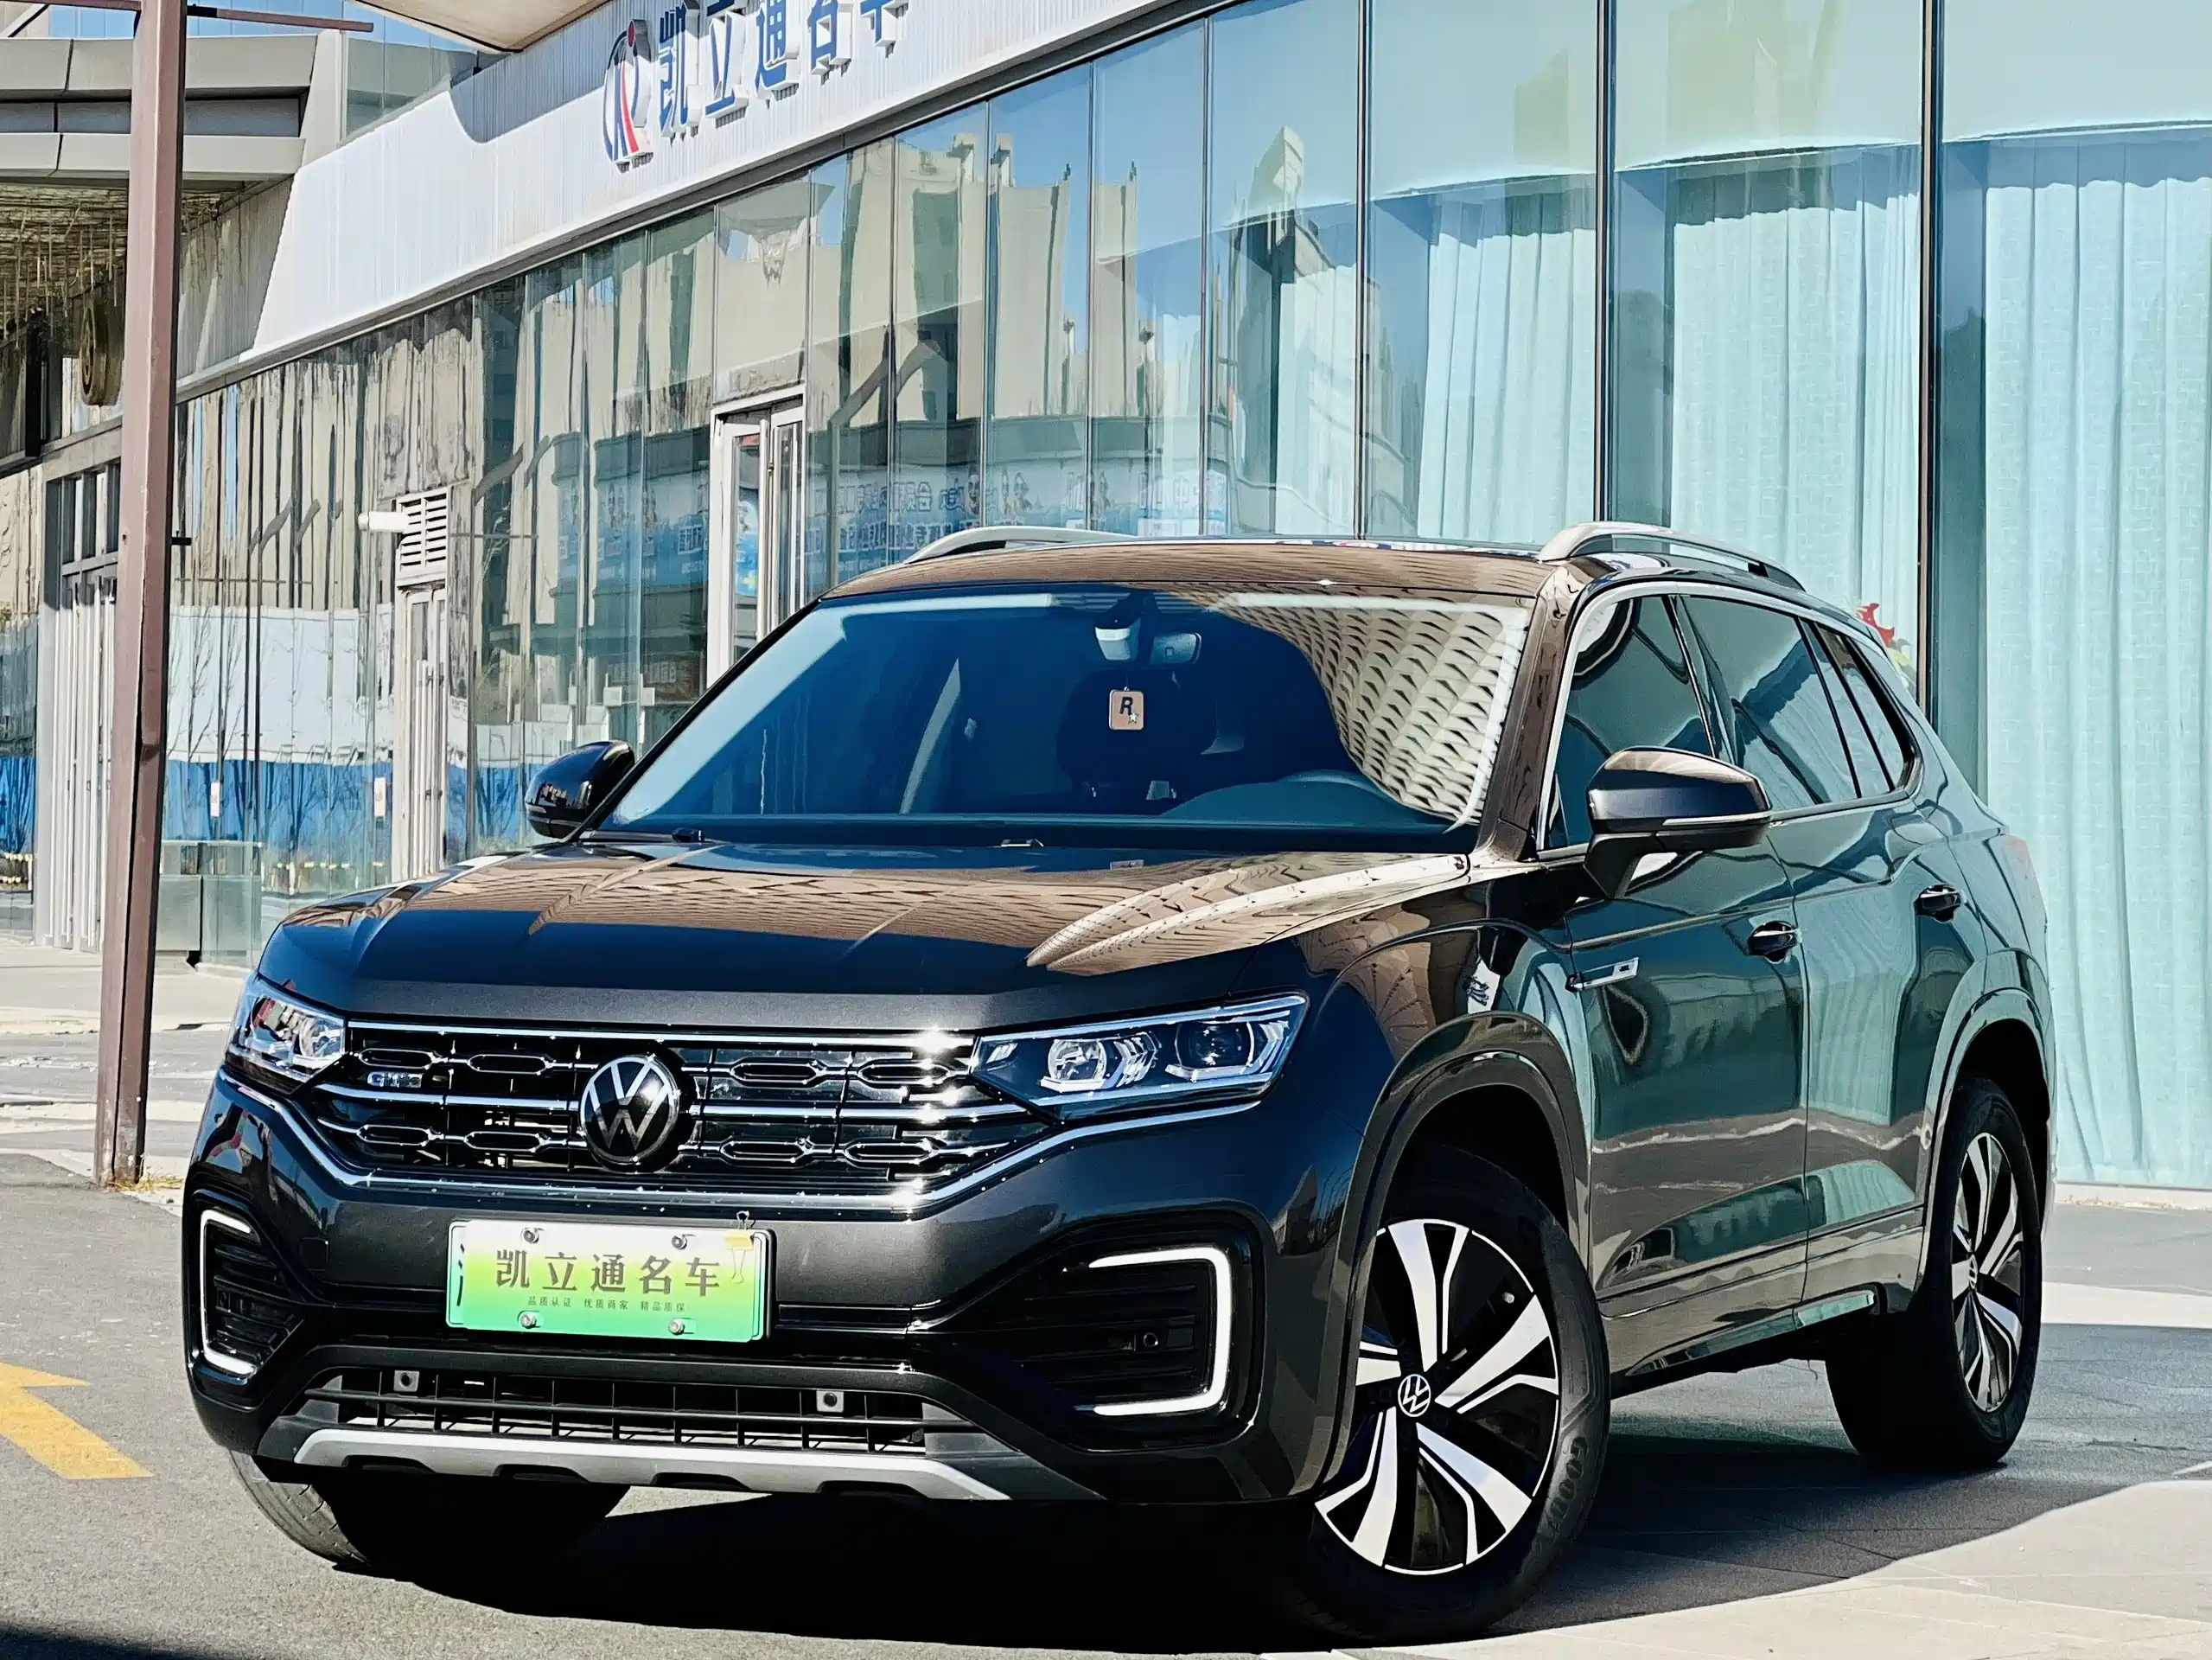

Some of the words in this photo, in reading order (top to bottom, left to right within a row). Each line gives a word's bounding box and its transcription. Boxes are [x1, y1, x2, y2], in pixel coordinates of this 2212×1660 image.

[1119, 696, 1133, 716] R
[495, 1249, 721, 1297] 凯立通名车
[527, 1296, 572, 1308] 品质认证
[583, 1298, 629, 1311] 优质商家
